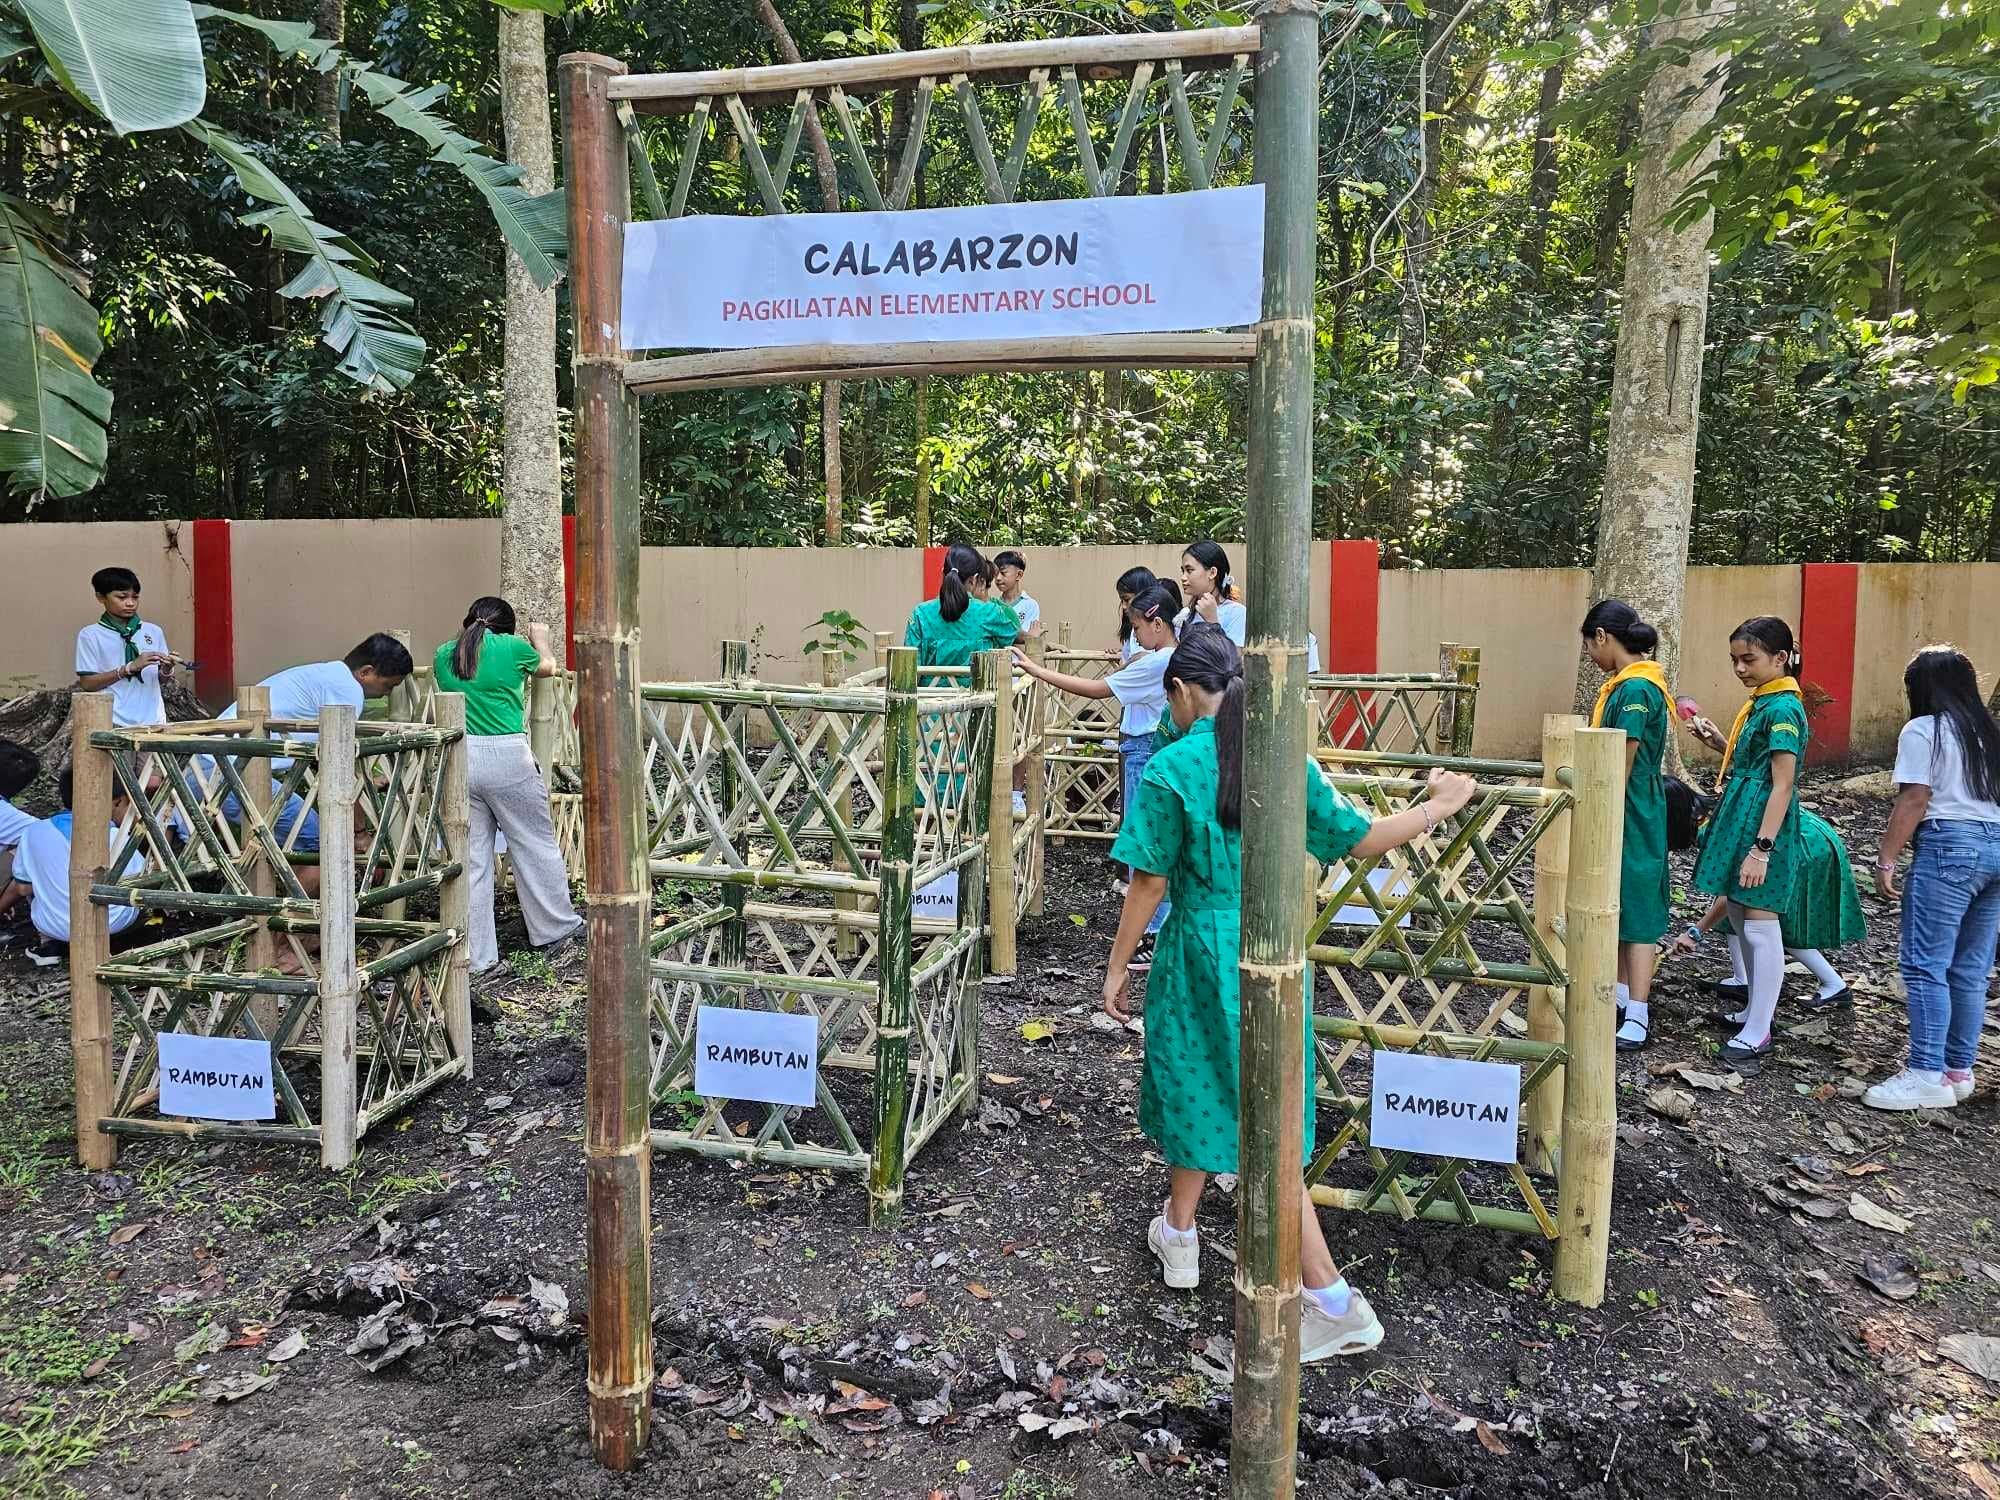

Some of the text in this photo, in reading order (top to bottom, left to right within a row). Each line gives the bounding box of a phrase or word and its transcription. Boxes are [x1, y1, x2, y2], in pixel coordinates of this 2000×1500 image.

[804, 231, 1079, 277] CALABARZON
[722, 283, 1157, 321] PAGKILATAN ELEMENTARY SCHOOL
[707, 1044, 809, 1070] RAMBUTAN
[168, 1067, 264, 1090] RAMBUTAN
[1385, 1093, 1509, 1123] RAMBUTAN
